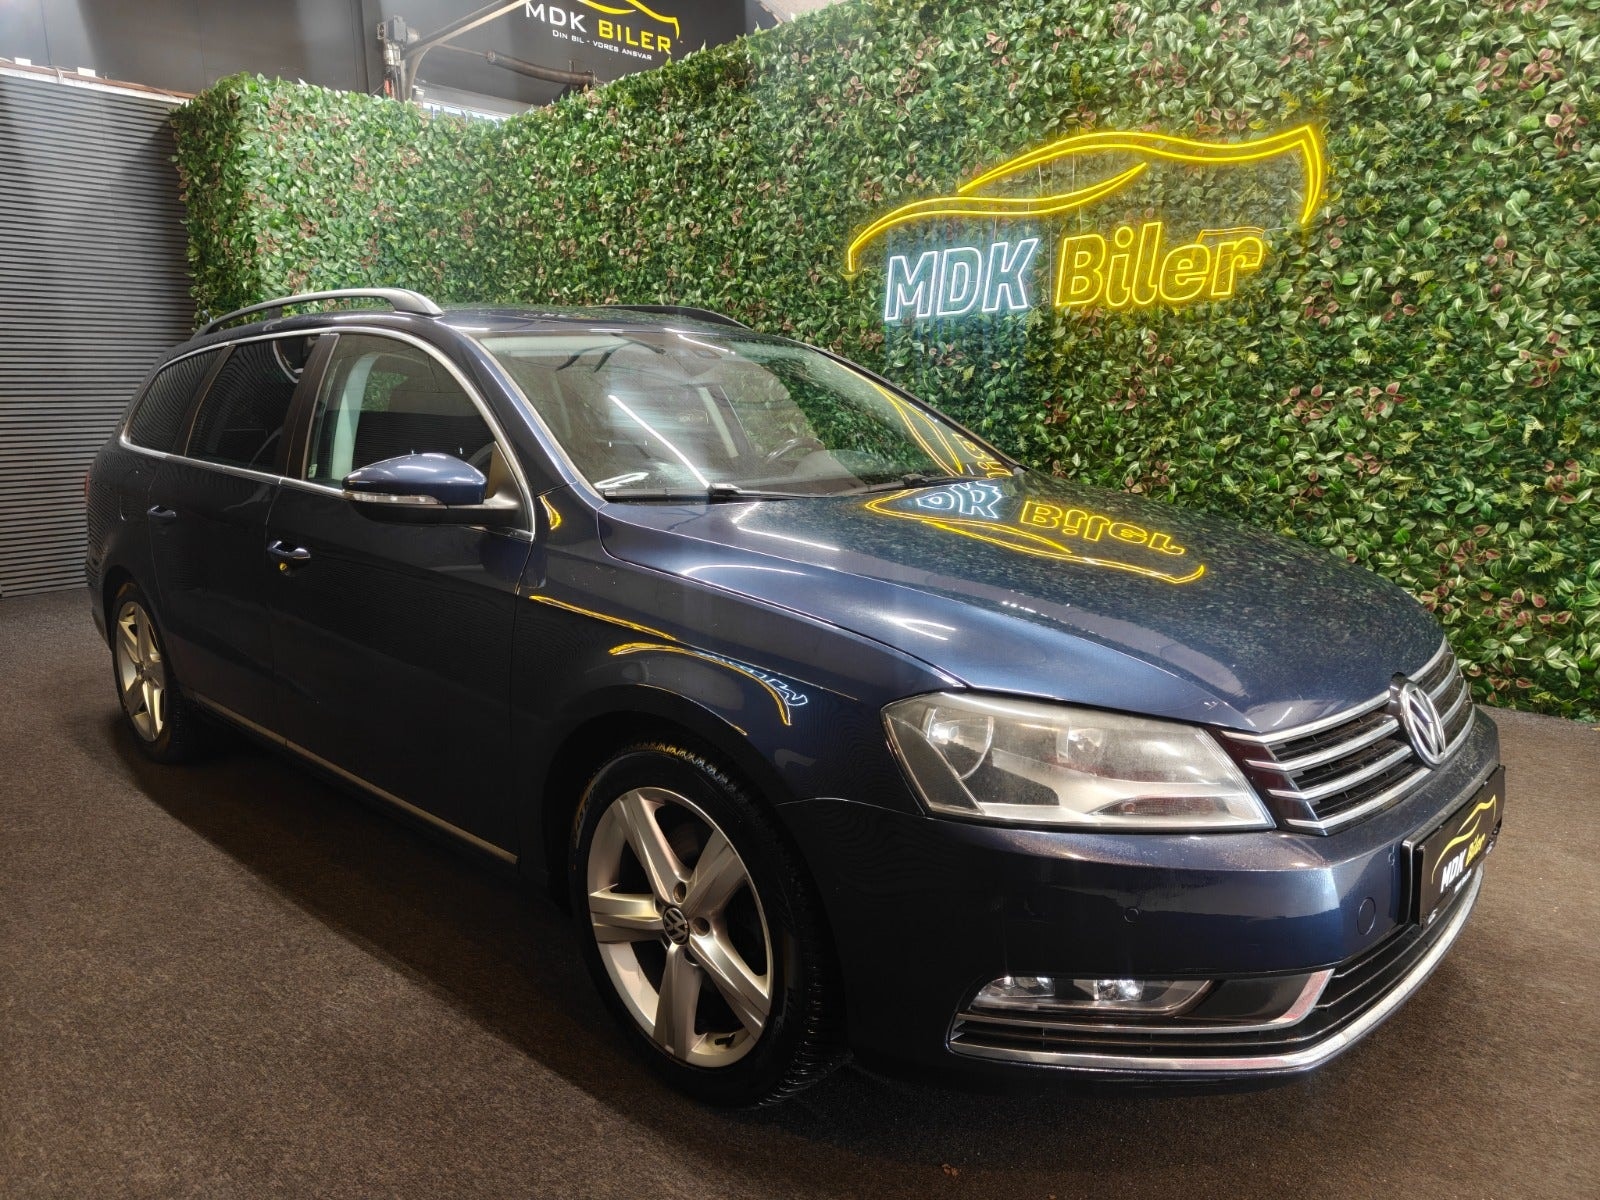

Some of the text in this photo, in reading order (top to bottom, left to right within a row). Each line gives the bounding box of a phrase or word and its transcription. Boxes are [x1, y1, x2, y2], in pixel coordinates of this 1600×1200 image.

[525, 1, 672, 55] MDK BILER
[571, 34, 585, 44] BIL
[592, 40, 619, 53] VORES
[621, 48, 653, 61] ANSVAR
[885, 222, 1265, 321] MDK Biler
[1440, 847, 1467, 893] MDK
